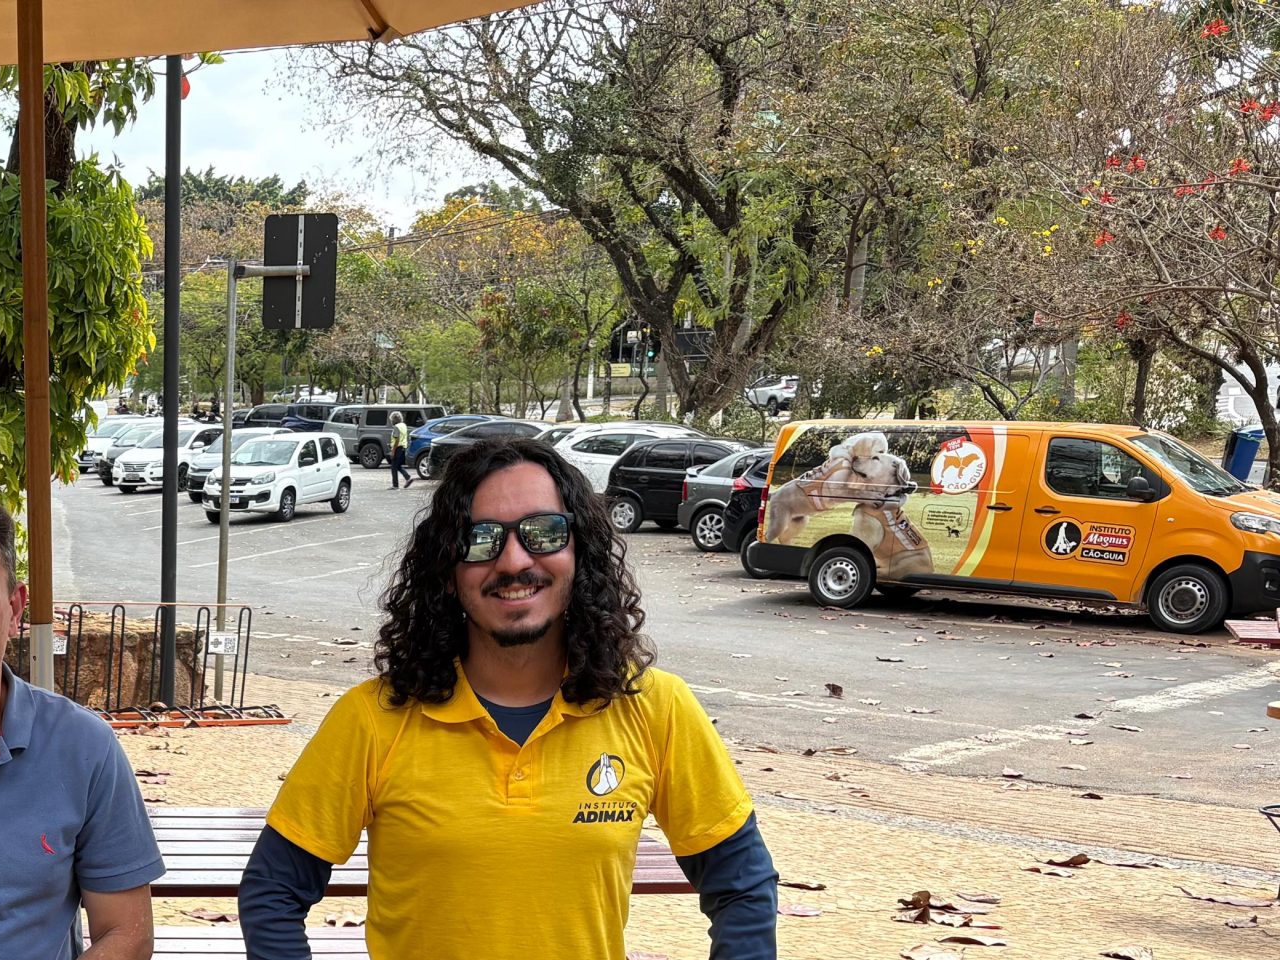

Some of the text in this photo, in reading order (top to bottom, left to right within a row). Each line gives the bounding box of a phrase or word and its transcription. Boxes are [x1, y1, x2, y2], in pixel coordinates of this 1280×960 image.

[947, 462, 984, 490] CÃO-GUIA
[1089, 525, 1131, 535] INSTITUTO
[1082, 533, 1128, 547] Magnus
[1082, 549, 1124, 561] CÃO-GUIA
[578, 801, 638, 810] INSTITUTO
[572, 809, 635, 824] ADIMAX
